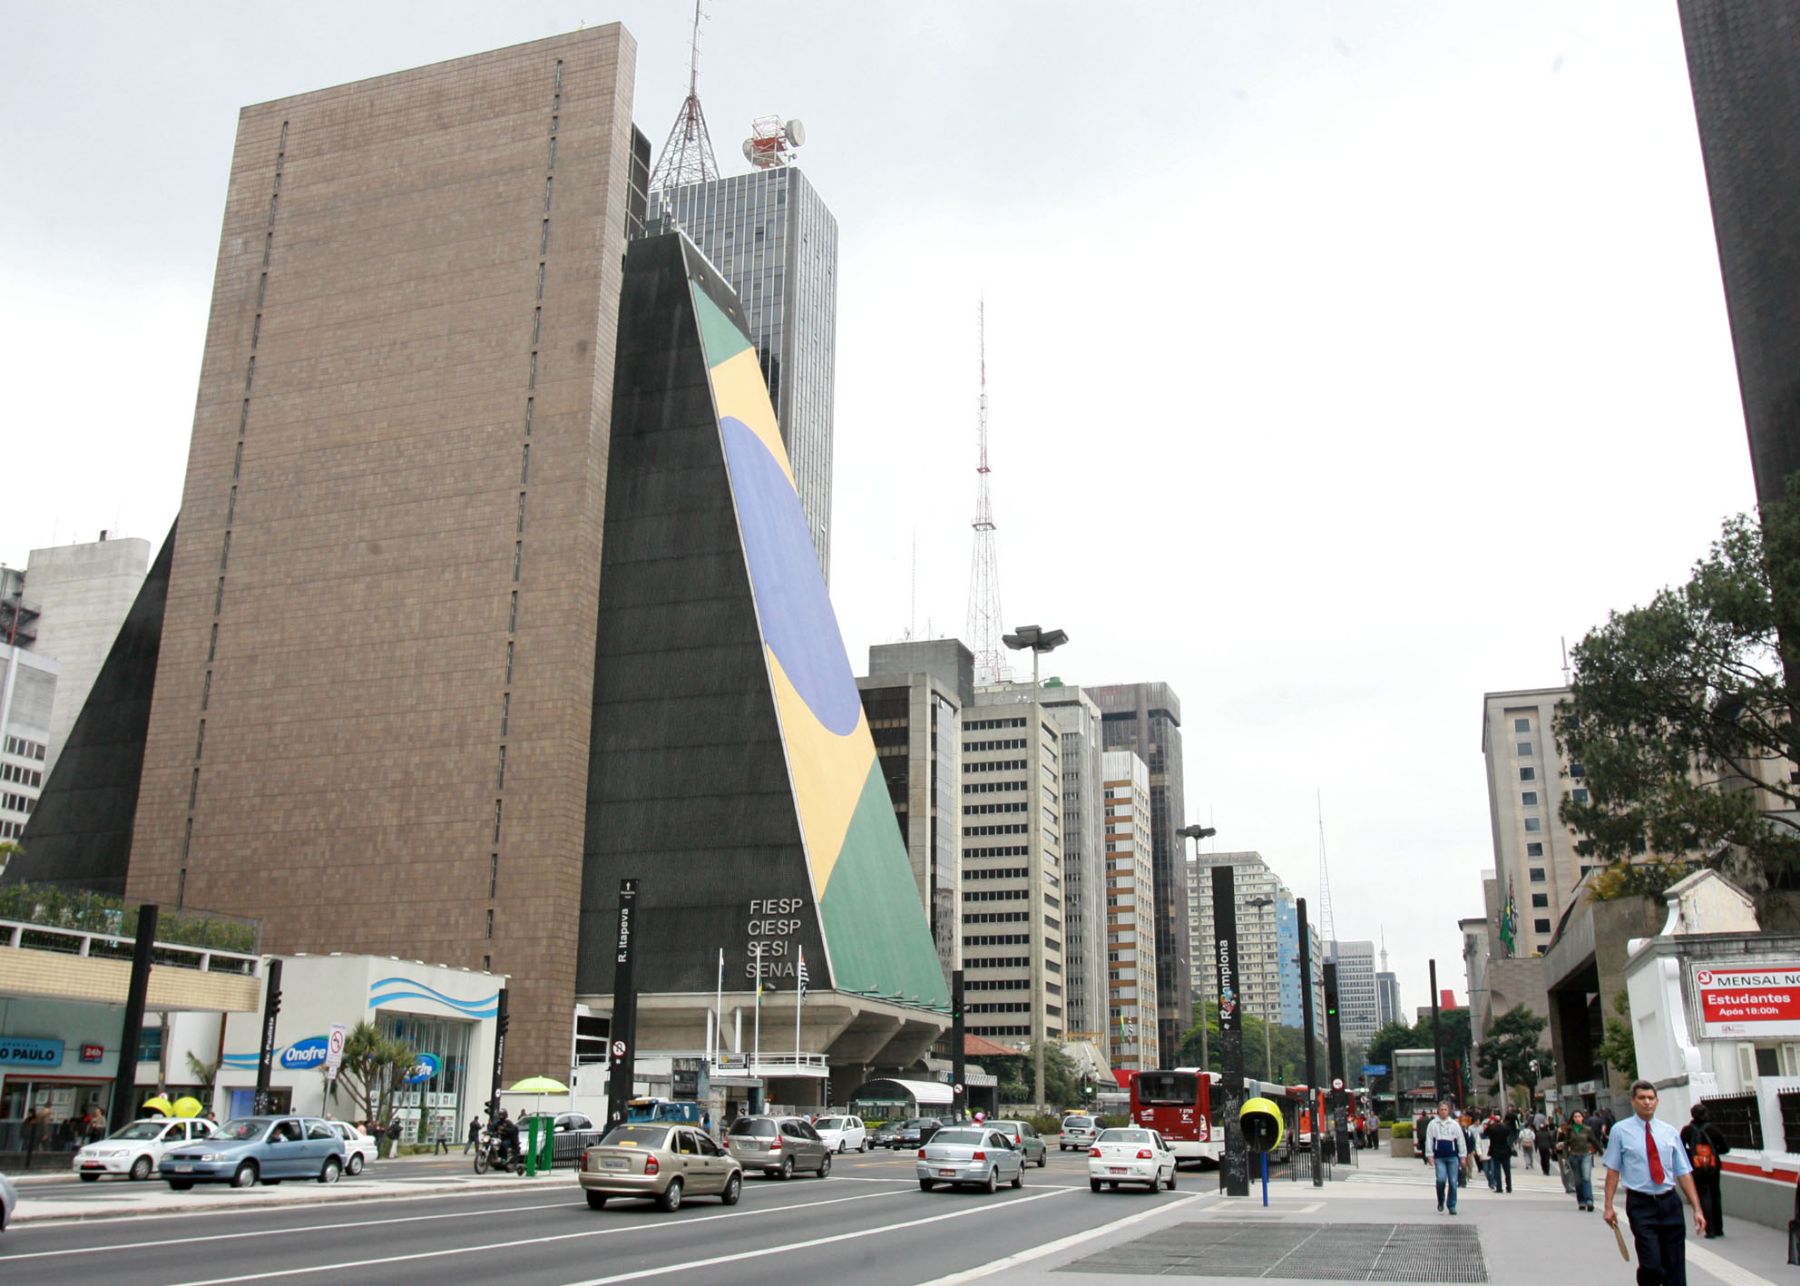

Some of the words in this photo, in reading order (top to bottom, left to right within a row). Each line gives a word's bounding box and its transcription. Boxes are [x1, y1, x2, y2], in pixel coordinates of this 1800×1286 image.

[750, 898, 803, 915] FIESP
[618, 908, 629, 949] Itapeva
[747, 919, 802, 936] CIESP
[746, 941, 789, 957] SESI
[617, 950, 627, 963] R.
[1717, 975, 1780, 987] MENSAL
[1707, 993, 1791, 1005] Estudantes
[1719, 1008, 1744, 1016] Após
[1745, 1006, 1779, 1015] 18:00h
[265, 1017, 273, 1050] Paulista
[12, 1048, 55, 1061] PAULO
[85, 1048, 102, 1057] 24h
[286, 1046, 326, 1062] Onofre
